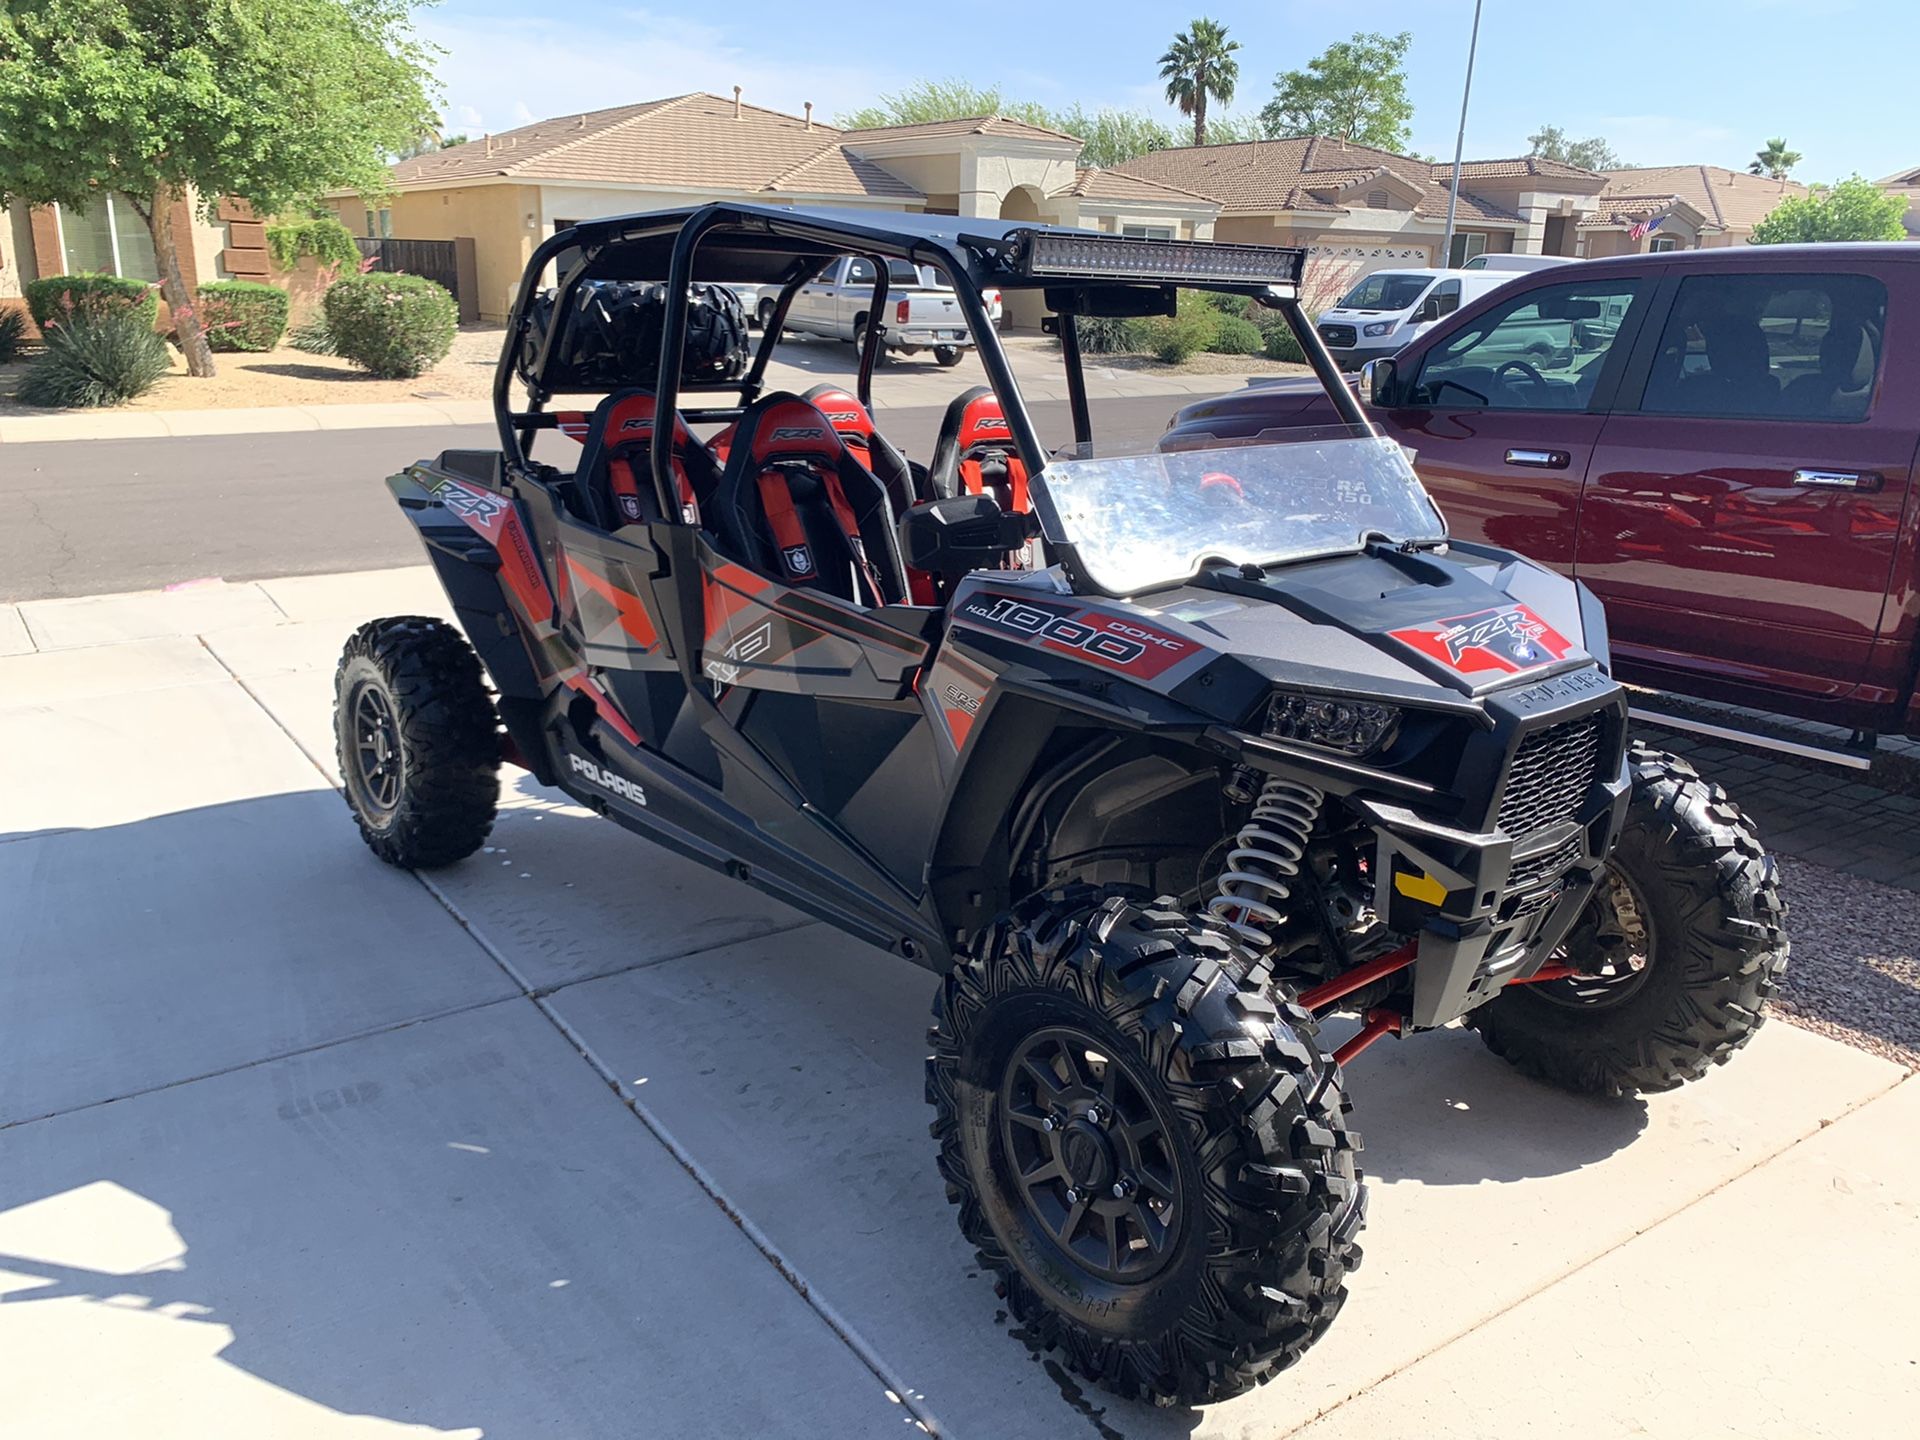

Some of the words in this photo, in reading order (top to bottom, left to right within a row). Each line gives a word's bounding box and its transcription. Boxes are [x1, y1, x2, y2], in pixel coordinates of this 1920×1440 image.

[620, 417, 656, 432] RZ
[824, 411, 860, 423] ZR
[973, 417, 1009, 431] RZ
[769, 426, 825, 442] RZR
[431, 479, 500, 528] RZR
[986, 598, 1146, 664] 1000
[1106, 621, 1185, 651] DOHC
[1445, 610, 1537, 666] RZR
[706, 622, 771, 699] XP
[945, 683, 981, 711] EPS
[569, 753, 647, 806] POLARIS
